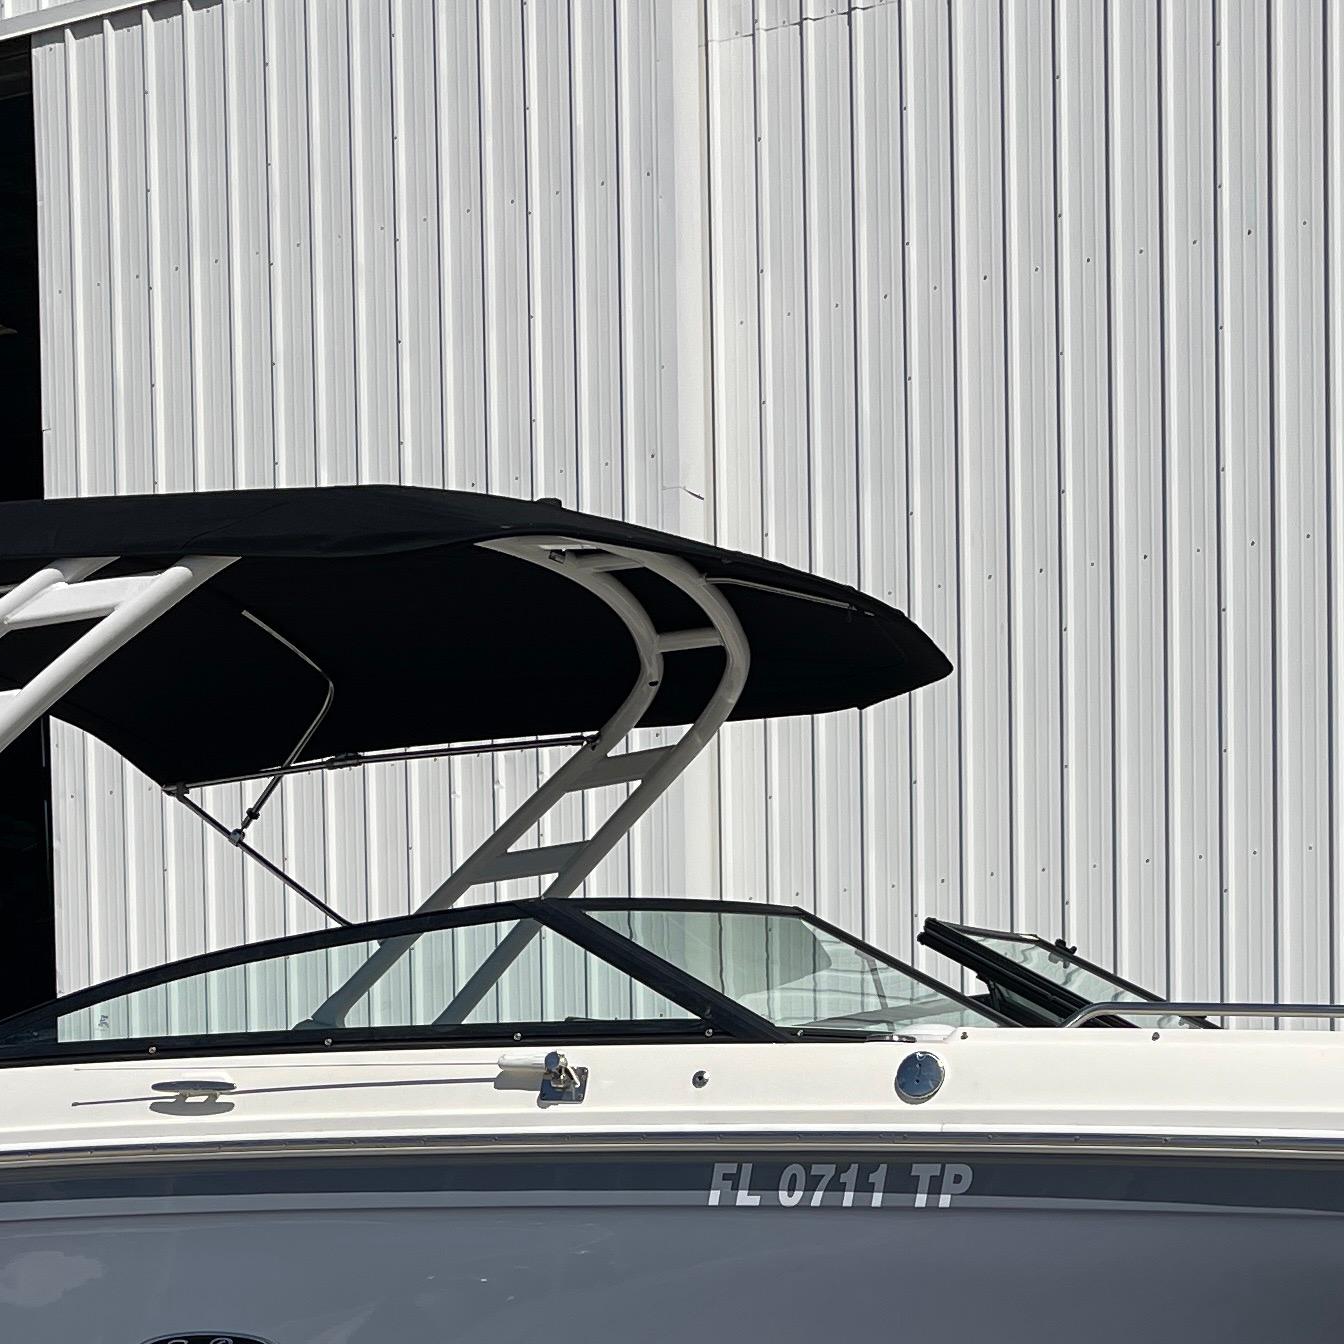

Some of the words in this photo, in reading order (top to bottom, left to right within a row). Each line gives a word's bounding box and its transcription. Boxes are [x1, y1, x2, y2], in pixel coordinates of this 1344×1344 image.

[707, 1162, 761, 1206] FL
[777, 1162, 889, 1208] 0711
[910, 1162, 974, 1208] TP
